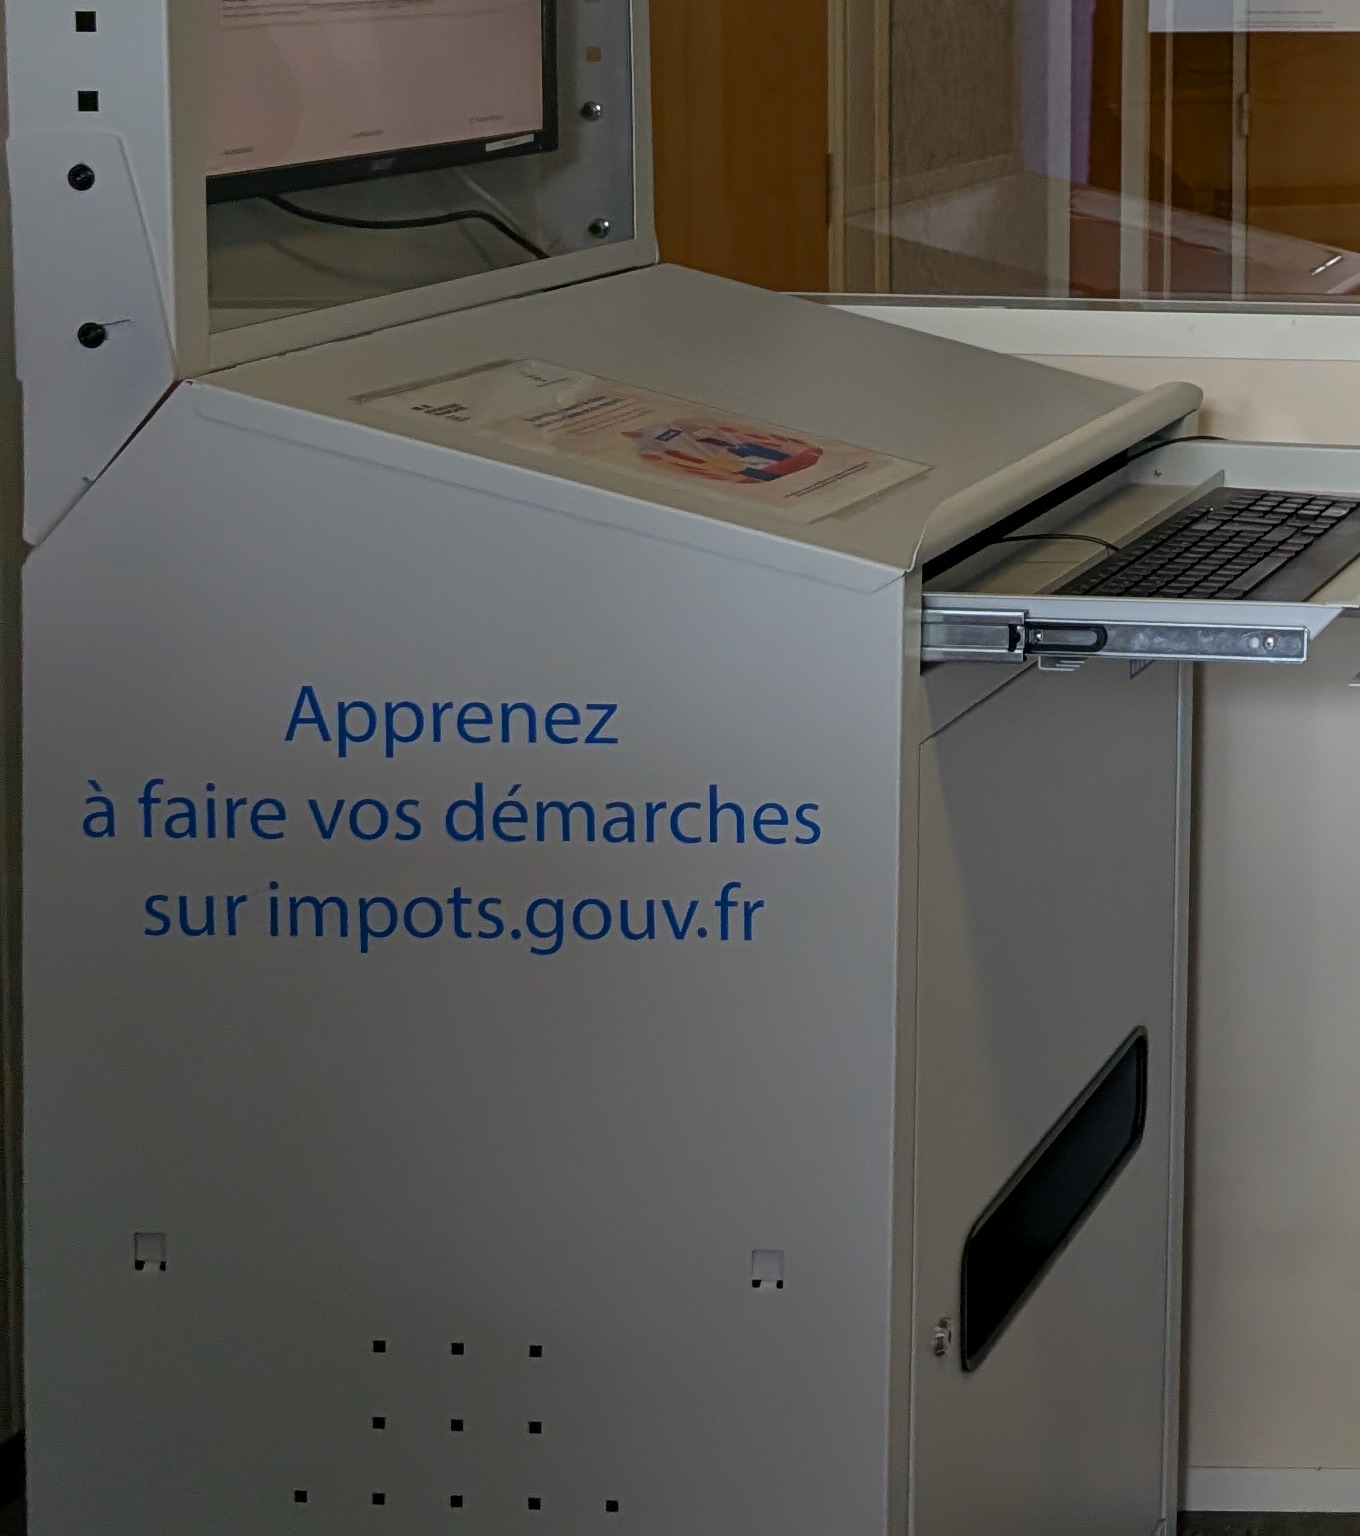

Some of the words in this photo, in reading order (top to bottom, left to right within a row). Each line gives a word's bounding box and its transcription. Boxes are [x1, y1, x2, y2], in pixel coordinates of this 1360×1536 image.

[285, 686, 620, 758] Apprenez
[83, 781, 116, 839] à
[140, 780, 286, 840] faire
[310, 800, 423, 842] vos
[445, 784, 823, 846] démarches
[143, 894, 247, 937] sur
[268, 882, 766, 957] impots.gouv.fr
